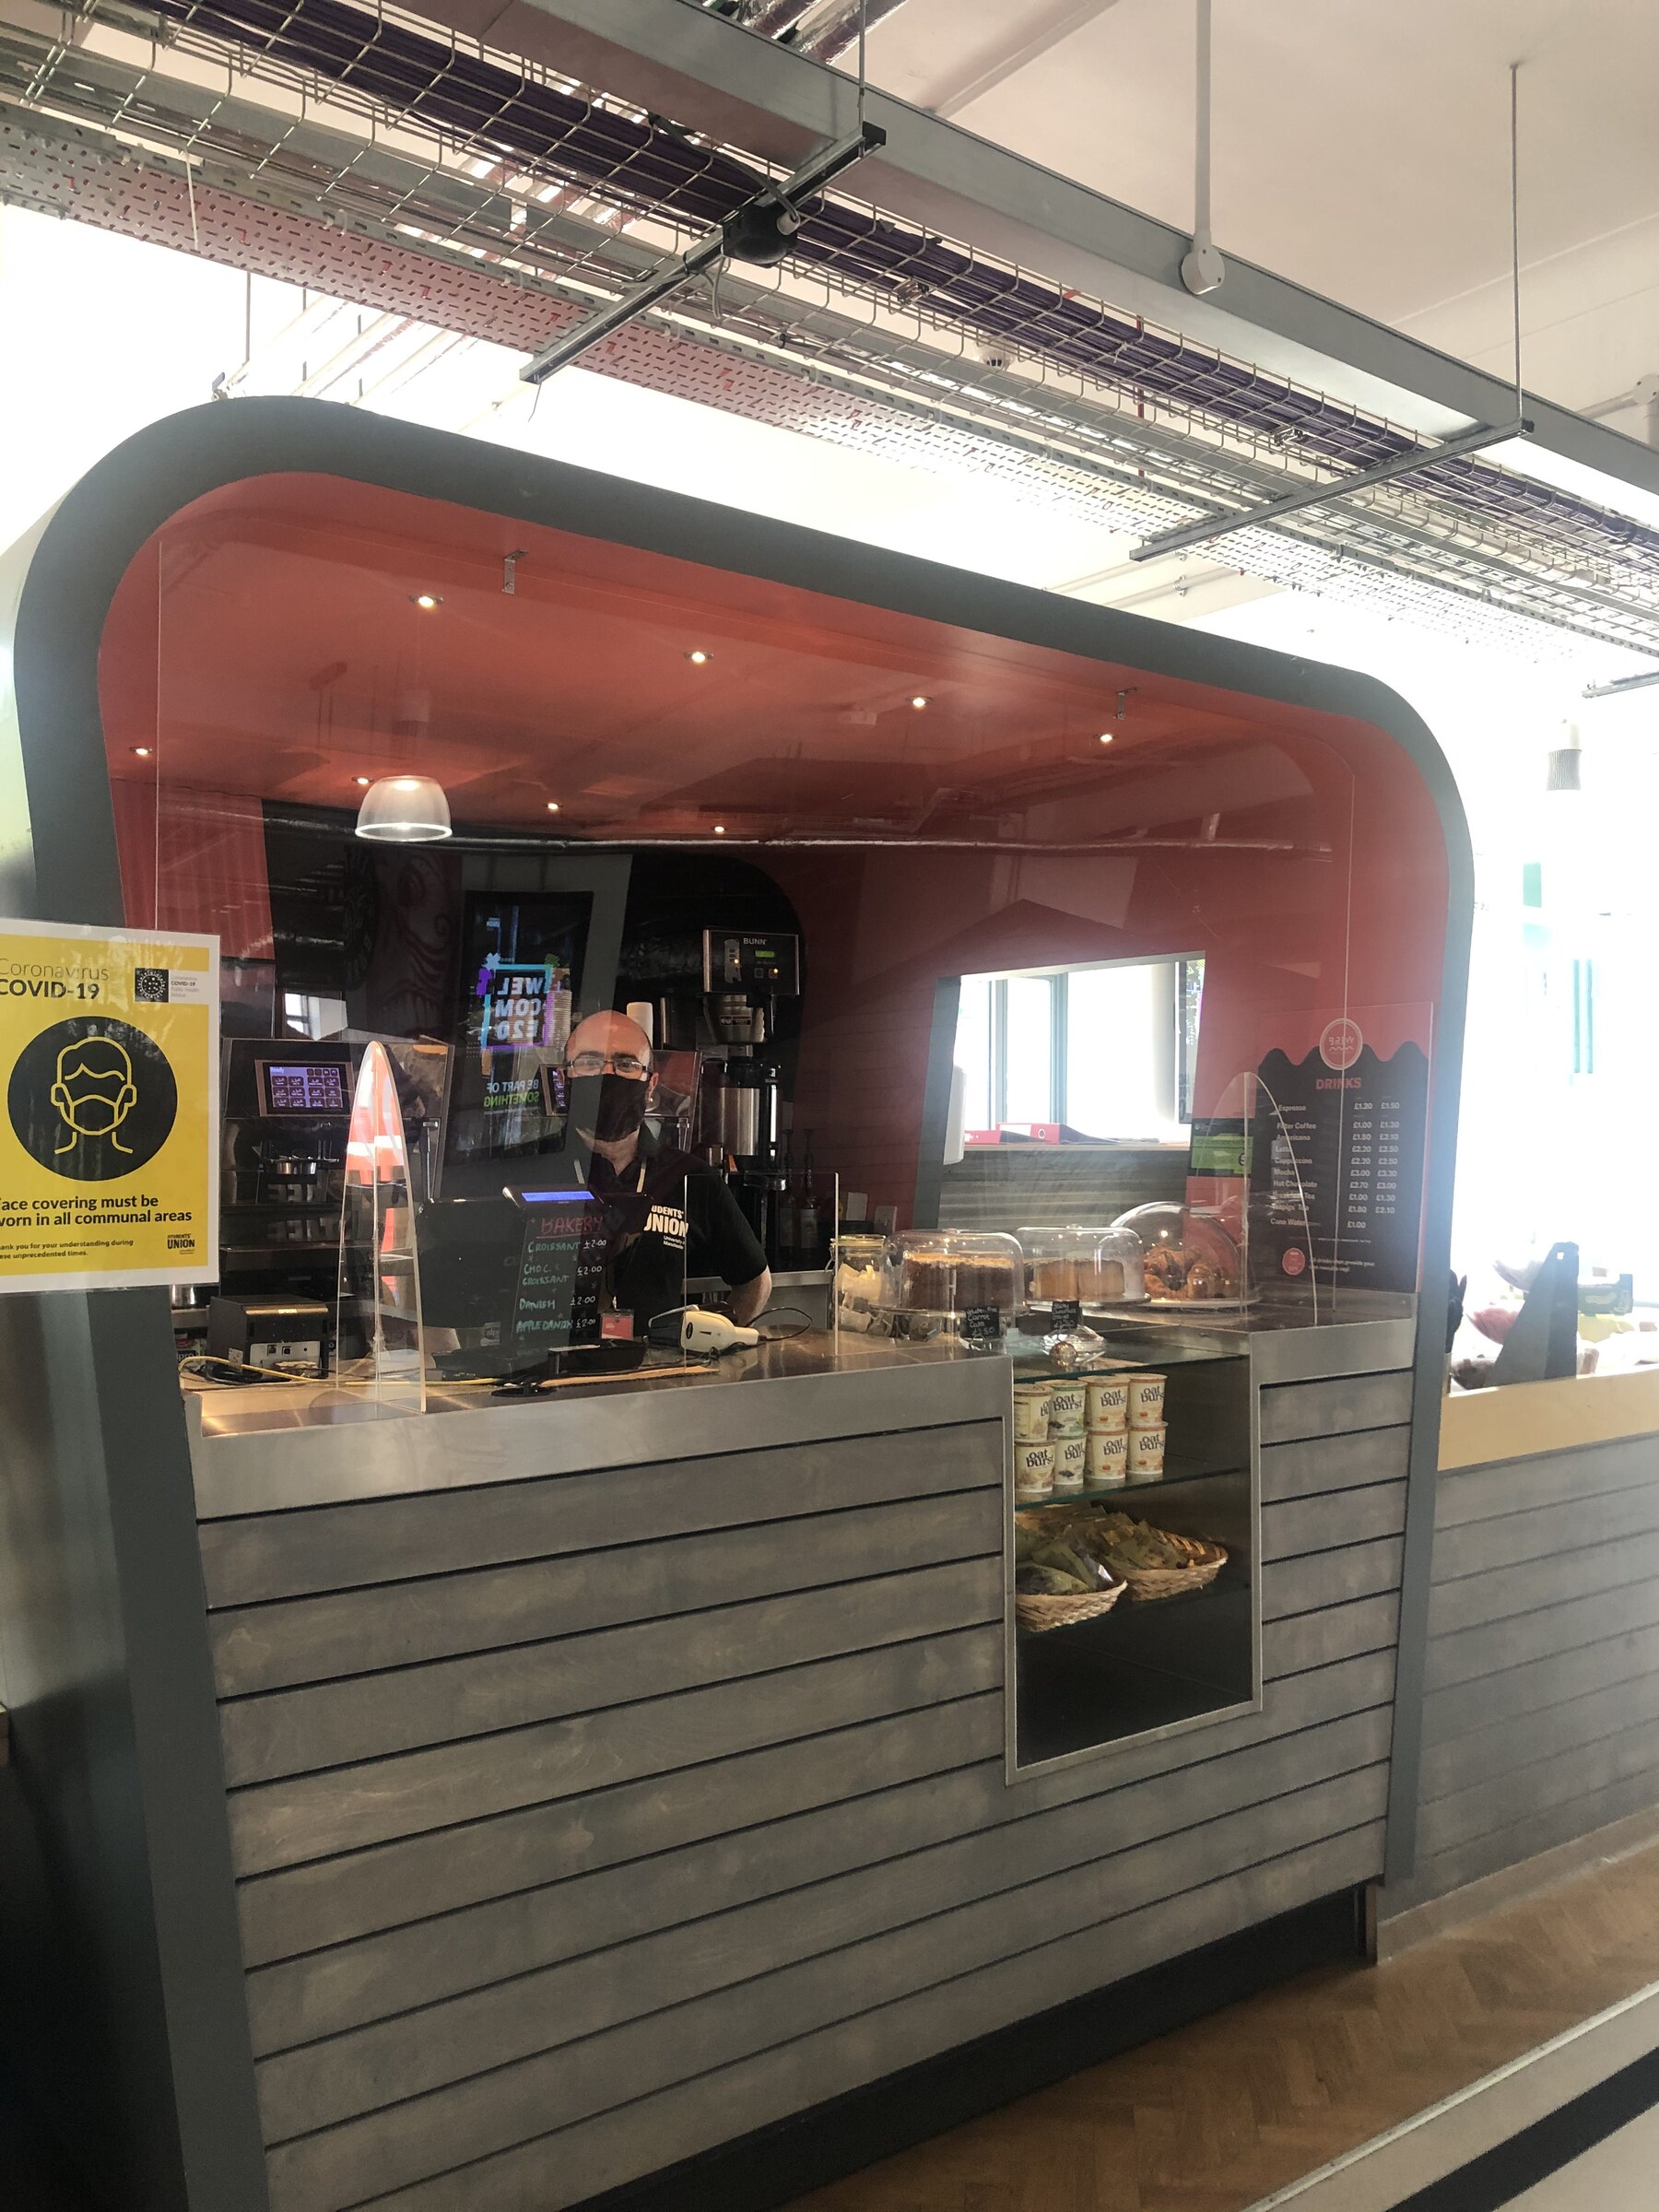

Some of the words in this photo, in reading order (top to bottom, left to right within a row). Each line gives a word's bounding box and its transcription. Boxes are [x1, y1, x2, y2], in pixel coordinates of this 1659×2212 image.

[1315, 1077, 1361, 1089] DRINKS
[0, 1199, 28, 1211] ace
[32, 1196, 97, 1210] covering
[101, 1195, 136, 1208] must
[141, 1194, 159, 1206] be
[36, 1212, 50, 1226] in
[53, 1212, 71, 1225] all
[75, 1209, 151, 1225] communal
[154, 1211, 193, 1223] areas
[651, 1205, 684, 1219] UDENTS'
[541, 1216, 604, 1234] BAKERY
[16, 1243, 29, 1252] you
[59, 1240, 110, 1250] understanding
[111, 1239, 134, 1248] during
[167, 1239, 195, 1249] UNION
[13, 1250, 66, 1260] unprecedented
[67, 1249, 88, 1257] times.
[1103, 1390, 1122, 1399] oat
[1144, 1385, 1160, 1394] oat
[1056, 1394, 1076, 1404] oat
[1106, 1438, 1123, 1448] oat
[1142, 1434, 1159, 1444] oat
[1067, 1442, 1084, 1453] oat
[1030, 1449, 1049, 1459] oat
